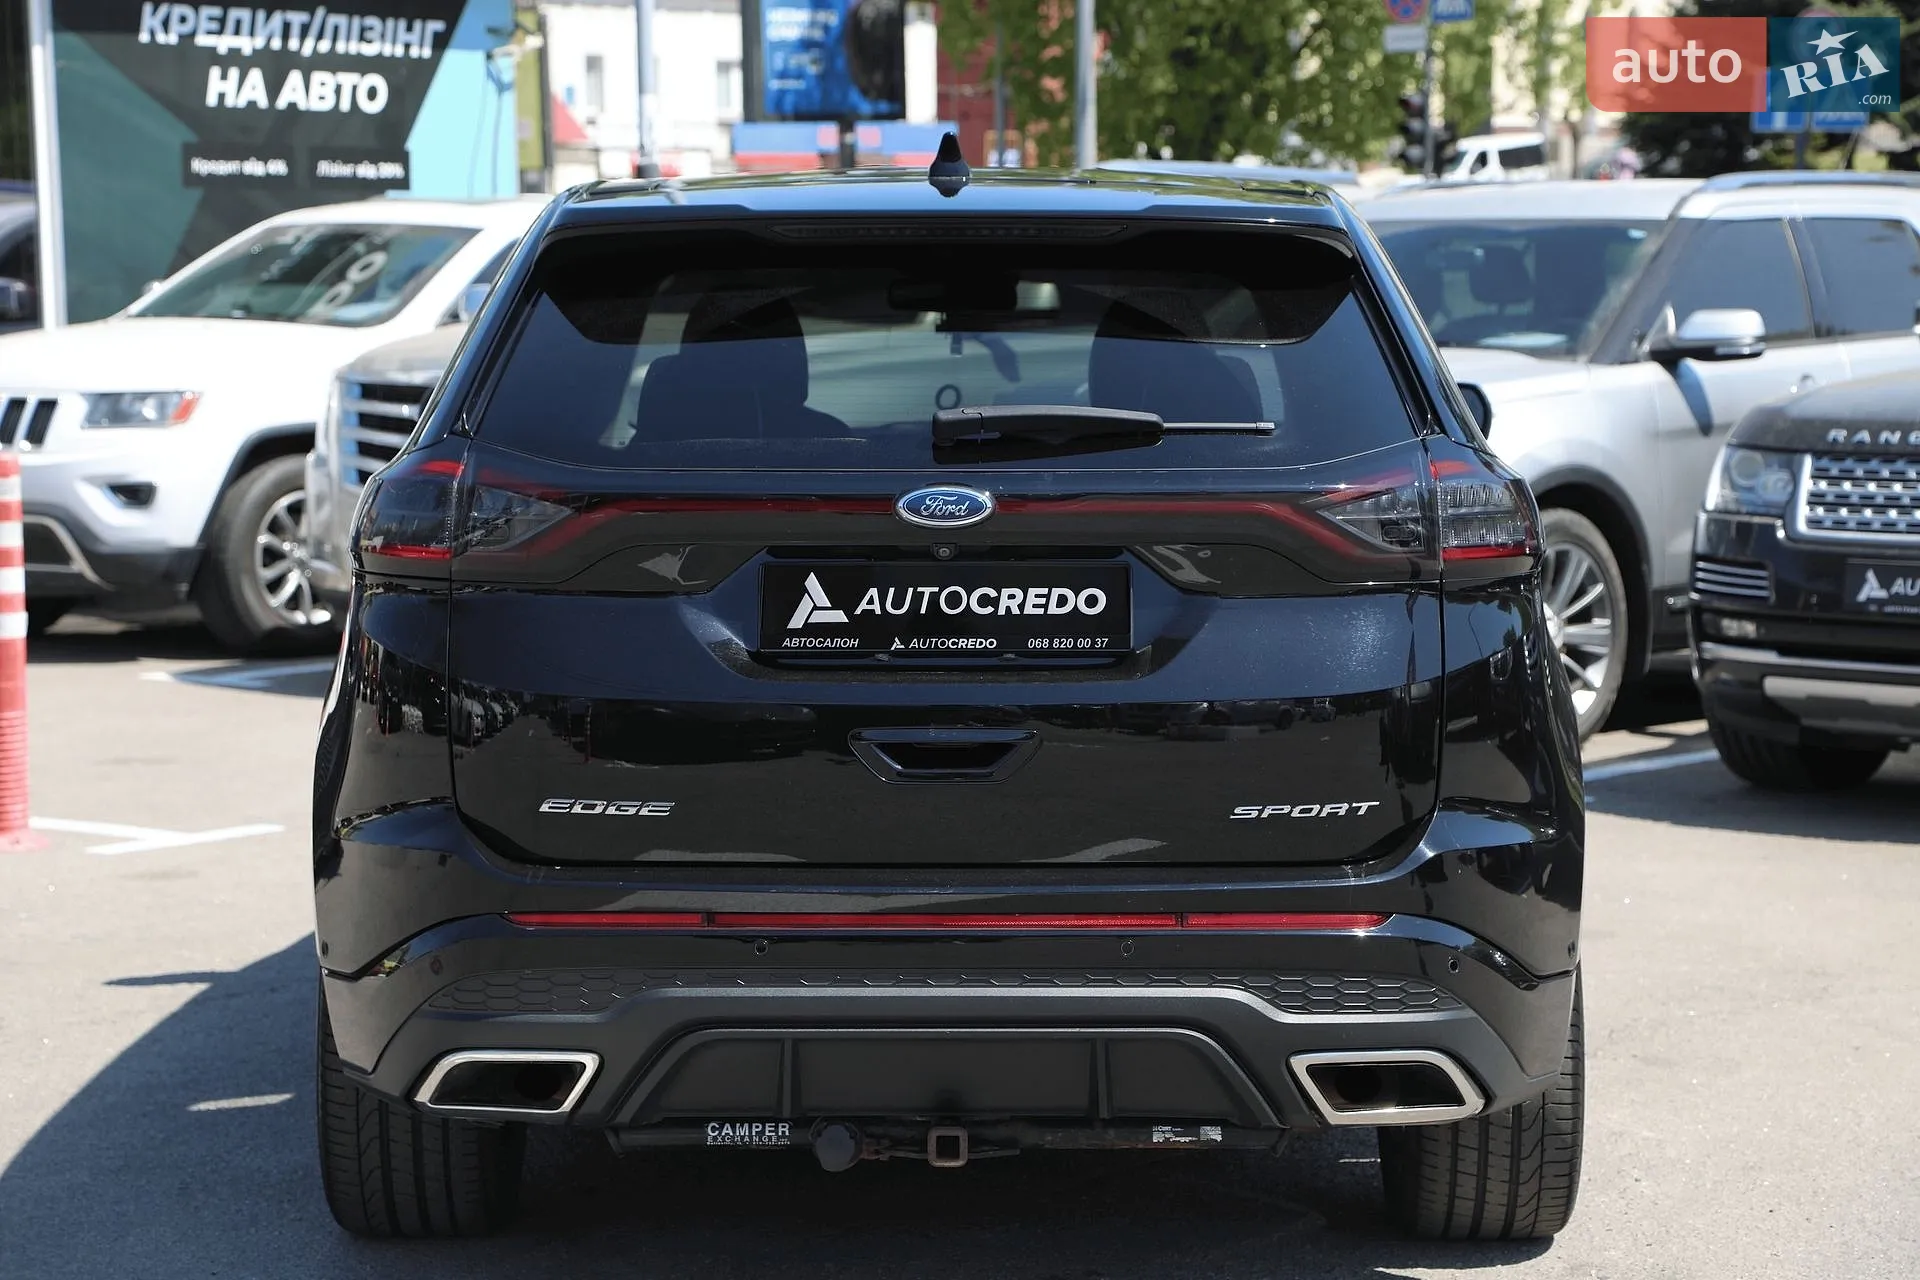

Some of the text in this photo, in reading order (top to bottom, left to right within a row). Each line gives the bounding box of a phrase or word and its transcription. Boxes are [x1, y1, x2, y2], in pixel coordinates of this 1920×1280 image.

[138, 1, 447, 59] КРЕДИТ/ЛІЗІНГ
[205, 65, 389, 114] НА АВТО
[921, 495, 970, 516] Ford
[854, 585, 1107, 616] AUTOCREDO
[782, 637, 859, 648] АВТОСАЛОН
[908, 638, 997, 649] AUTOCREDO
[1027, 638, 1109, 648] 068 820 00 37
[539, 798, 676, 816] EDGE
[1229, 801, 1380, 819] SPORT
[707, 1122, 790, 1136] CAMPER
